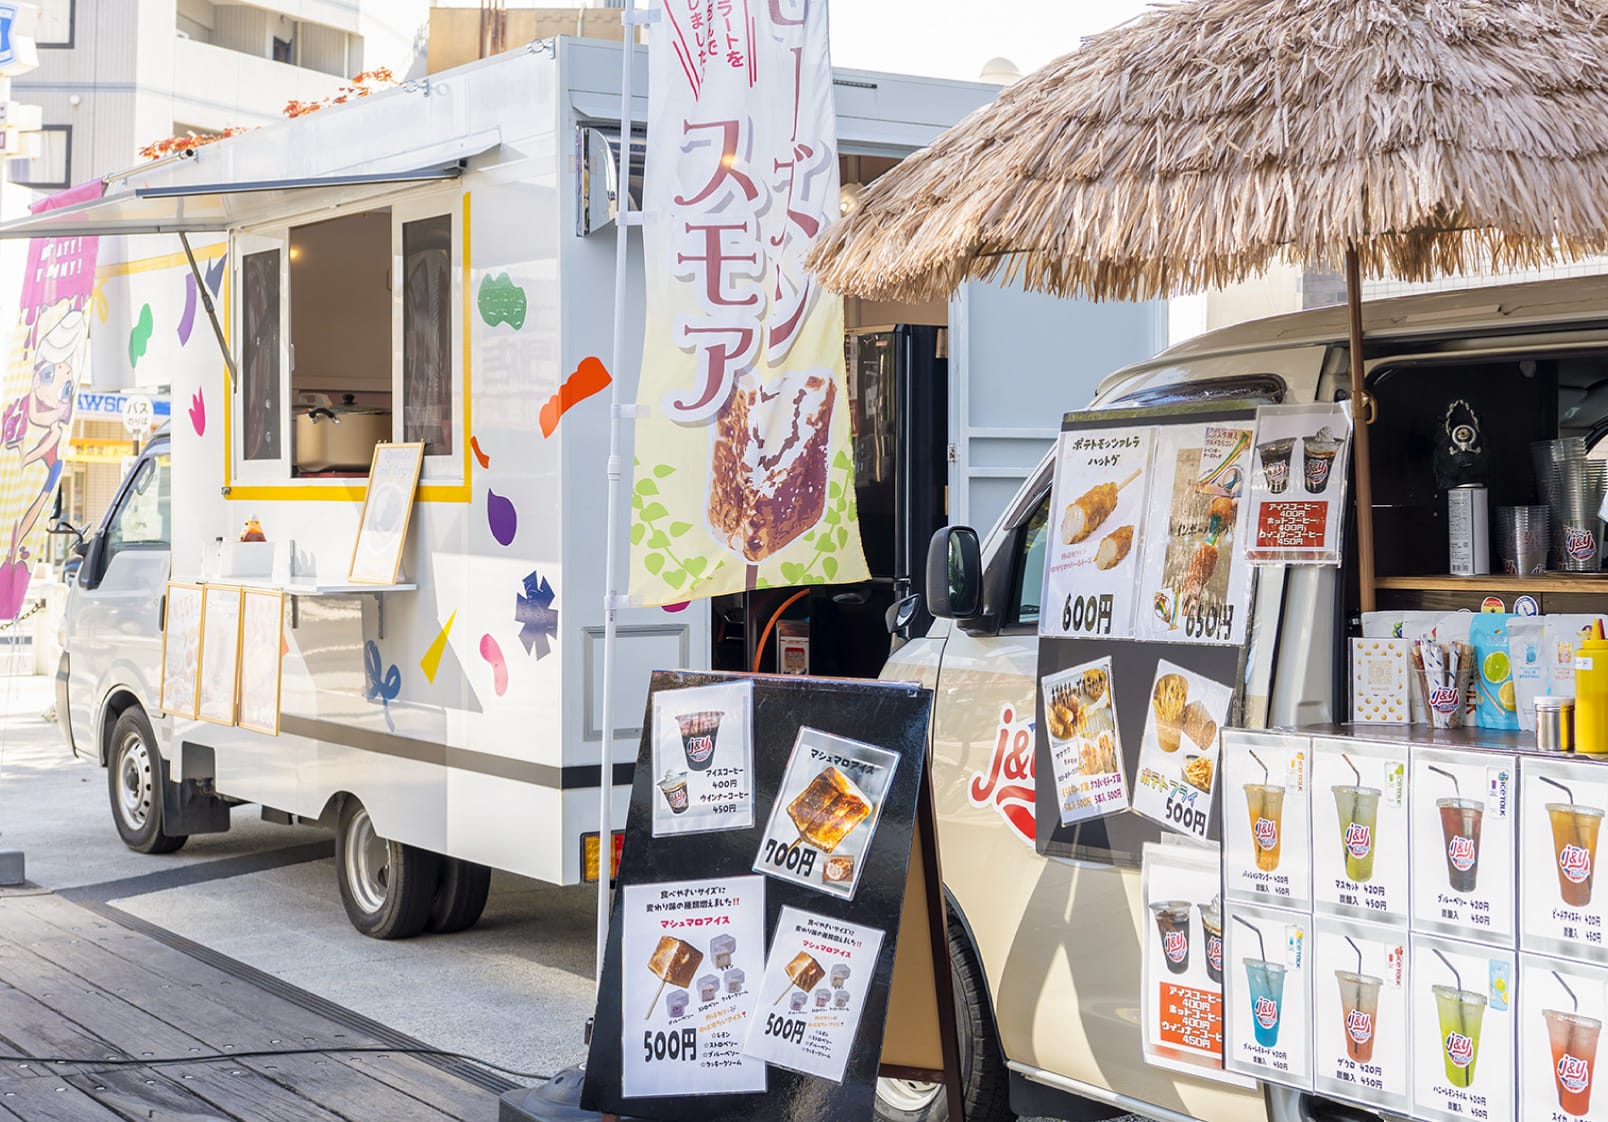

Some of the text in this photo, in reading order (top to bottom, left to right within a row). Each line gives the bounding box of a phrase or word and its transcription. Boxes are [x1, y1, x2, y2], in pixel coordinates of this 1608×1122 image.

[673, 119, 760, 411] スモア
[127, 402, 148, 414] バス
[128, 417, 148, 425] のりば
[1087, 454, 1120, 466] ハットグ
[1268, 503, 1319, 511] アイスコーヒー
[1267, 517, 1318, 525] ホットコーヒー
[1277, 537, 1303, 545] 450円
[1062, 593, 1113, 634] 600円
[1431, 688, 1457, 704] j&y
[810, 748, 877, 775] マシュマロアイス
[972, 708, 1035, 802] j&
[705, 768, 744, 777] アイスコーヒー
[712, 780, 737, 789] 400円
[1140, 767, 1198, 808] ポテトフライ
[712, 804, 737, 814] 450円
[1165, 797, 1206, 836] 500円
[765, 838, 817, 877] 700円
[660, 887, 726, 899] 食べやすいサイズに
[1335, 880, 1385, 896] マスカット 420円
[1365, 899, 1387, 911] 450円
[660, 916, 730, 929] マシュマロアイス
[802, 939, 851, 958] マシュマロアイス
[1169, 986, 1222, 1004] アイスコーヒー
[1182, 999, 1210, 1012] 400円
[1169, 1005, 1222, 1022] ホットコーヒー
[764, 1012, 807, 1045] 500円
[1182, 1016, 1210, 1031] 400円
[644, 1028, 697, 1063] 500円
[1182, 1034, 1211, 1049] 450円
[1337, 1058, 1382, 1076] ザクロ 420円
[1361, 1077, 1382, 1089] 450円
